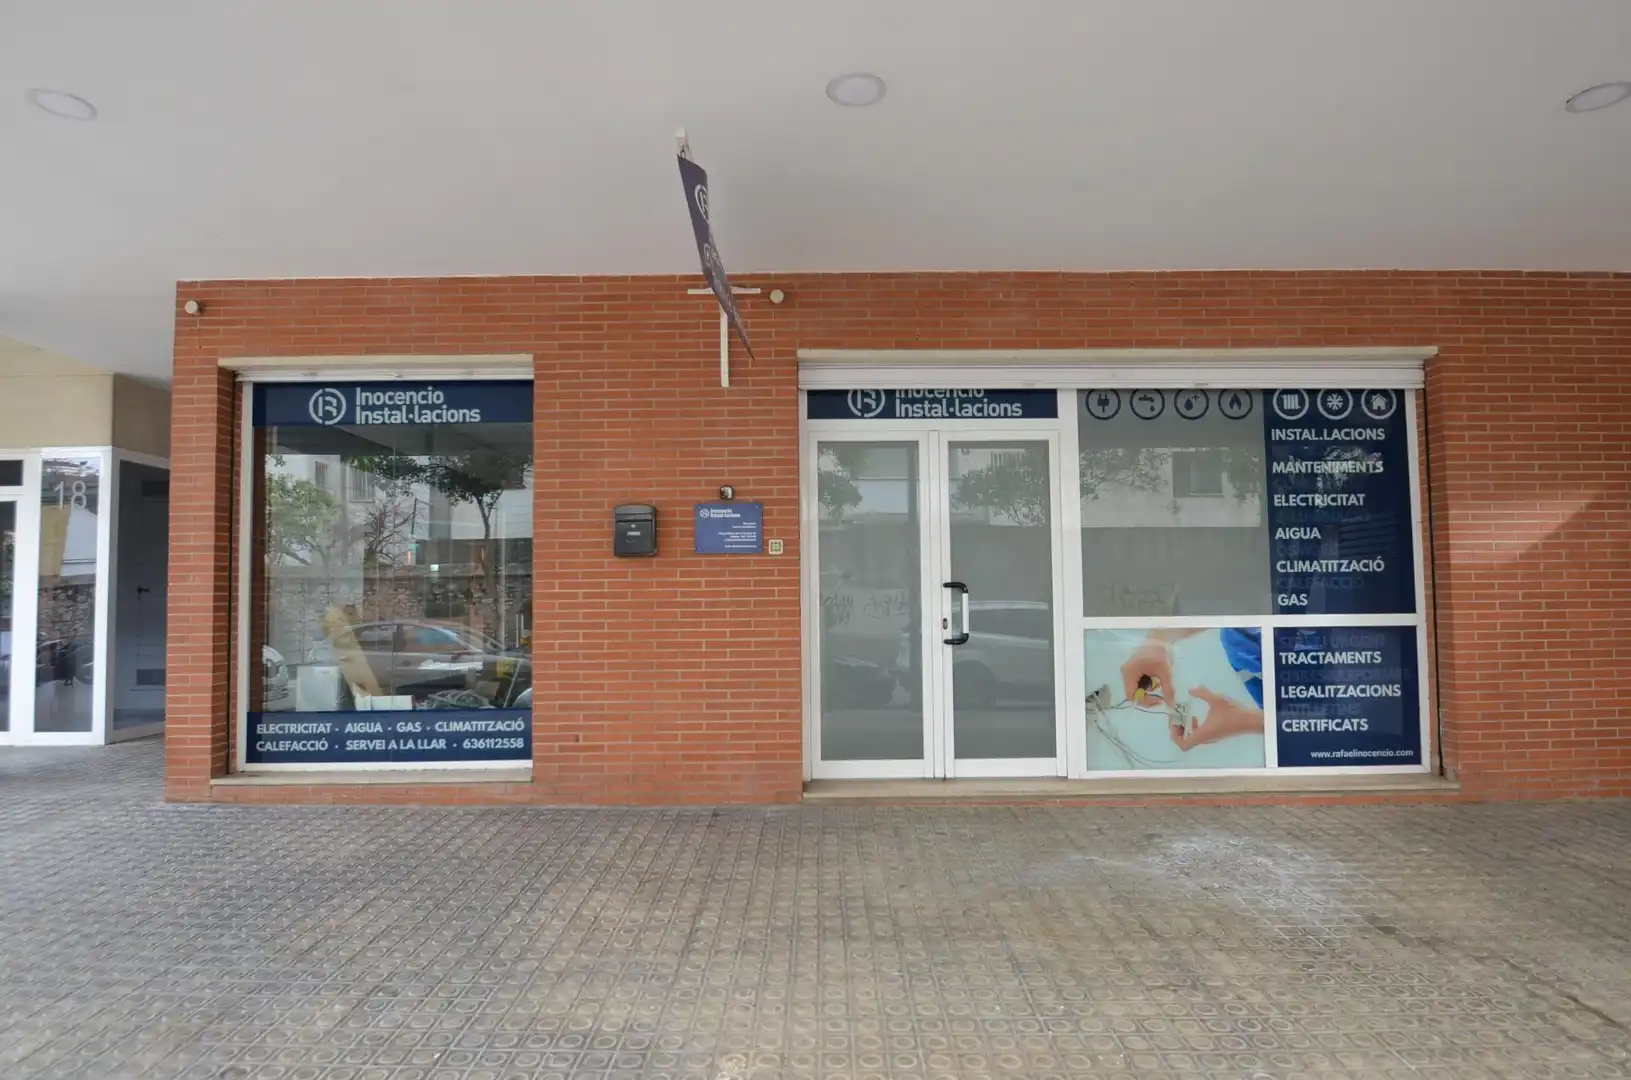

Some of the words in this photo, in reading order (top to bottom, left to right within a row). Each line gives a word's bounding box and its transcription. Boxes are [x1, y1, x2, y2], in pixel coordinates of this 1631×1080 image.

[356, 386, 444, 406] Inocencio
[356, 404, 481, 424] Instal·lacions
[895, 399, 1023, 417] Instal·lacions
[1271, 428, 1386, 441] INSTAL.LACIONS
[1272, 460, 1384, 474] MANTENIMENTS
[54, 480, 87, 511] 18
[1274, 494, 1366, 507] ELECTRICITAT
[1275, 527, 1322, 540] AIGUA
[1276, 556, 1385, 573] CLIMATITZACIÓ
[1277, 594, 1308, 606] GAS
[1280, 651, 1382, 665] TRACTAMENTS
[1281, 684, 1401, 699] LEGALITZACIONS
[256, 722, 332, 734] ELECTRICITAT
[344, 722, 383, 733] AIGUA
[396, 721, 421, 732] GAS
[435, 717, 525, 732] CLIMATITZACIÓ
[1282, 718, 1369, 732] CERTIFICATS
[256, 737, 328, 751] CALEFACCIÓ
[345, 739, 386, 751] SERVEI
[388, 739, 398, 750] A
[400, 739, 415, 750] LA
[417, 738, 446, 750] LLAR
[462, 738, 524, 749] 636112558
[1310, 748, 1414, 758] www.rafaelinocencio.com
